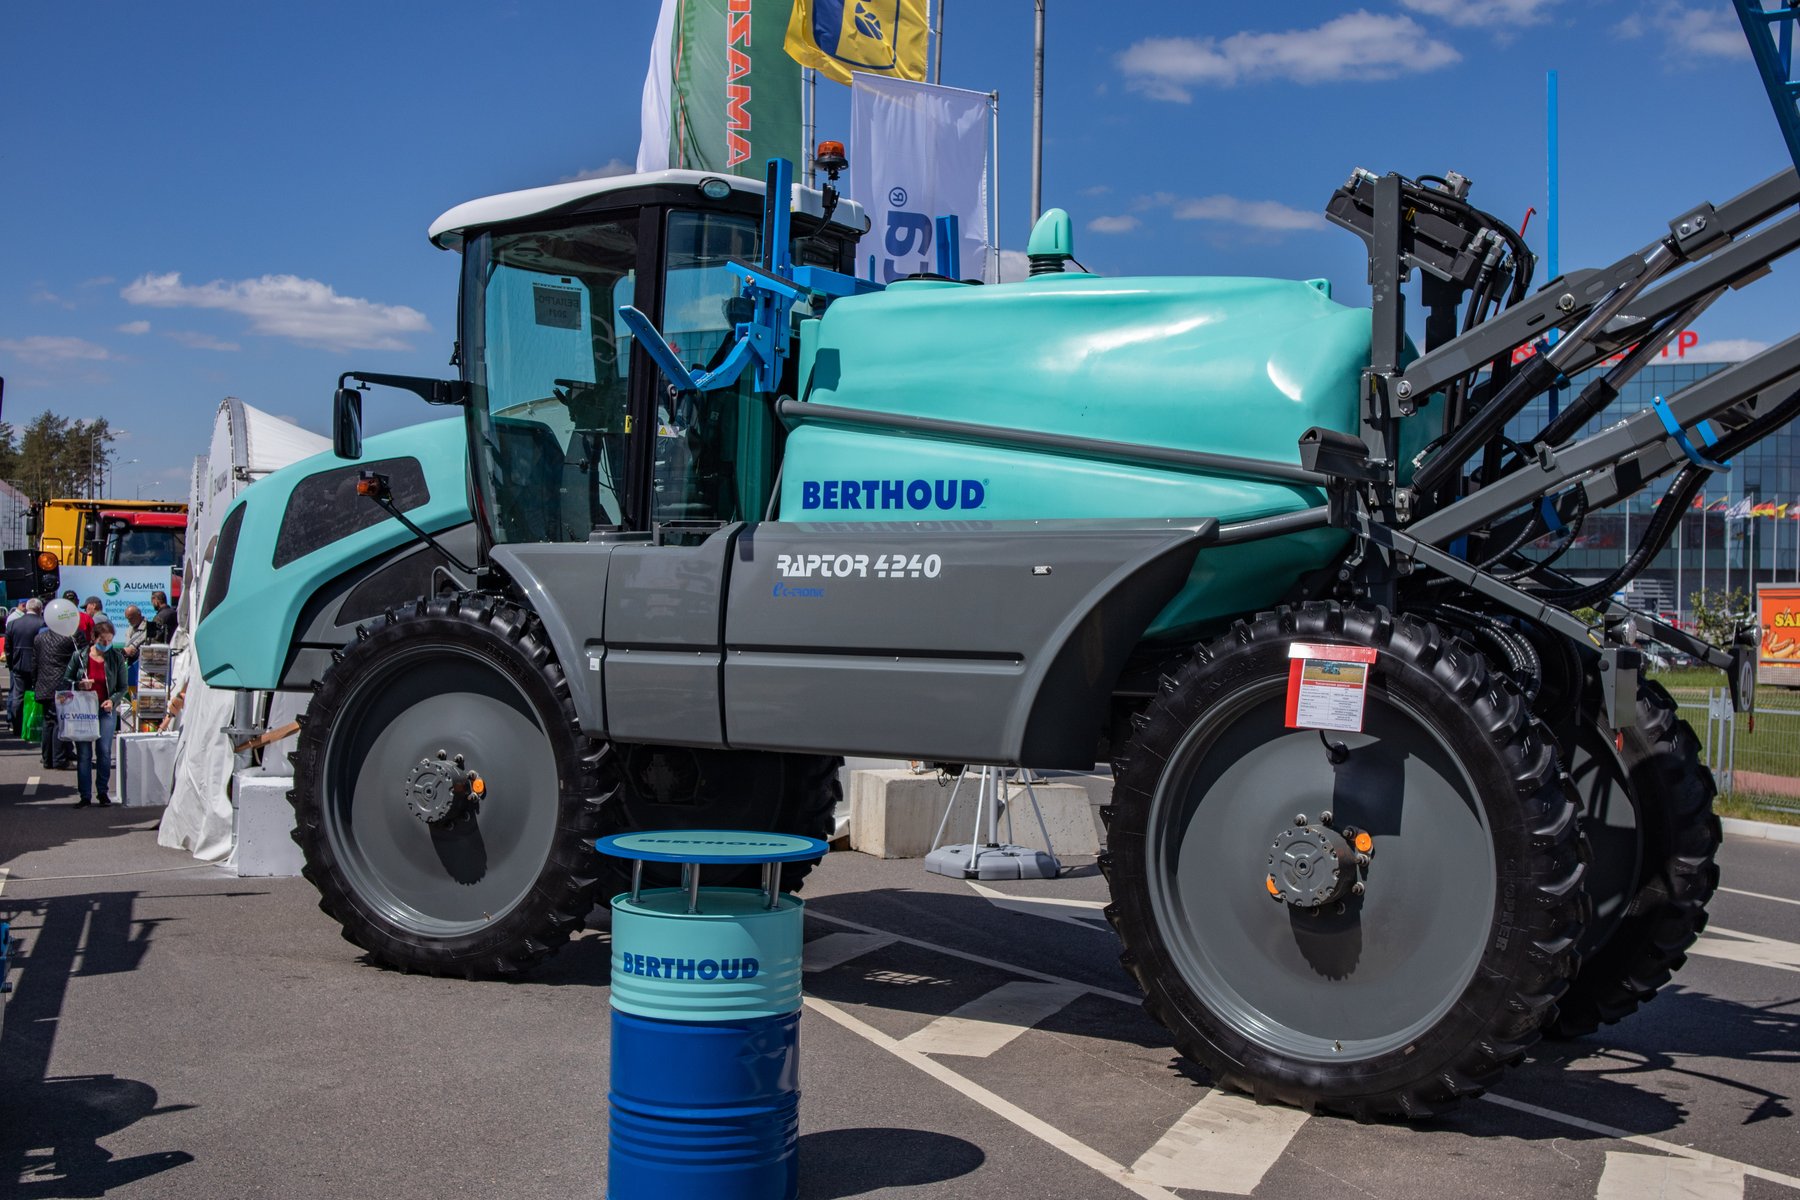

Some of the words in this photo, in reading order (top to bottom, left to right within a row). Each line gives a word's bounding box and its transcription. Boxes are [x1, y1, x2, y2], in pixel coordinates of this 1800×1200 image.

[776, 554, 868, 578] RAPTOR
[873, 553, 942, 578] 4240
[124, 582, 165, 590] AUGMENTA
[638, 838, 788, 847] BERTHOUD
[623, 951, 760, 981] BERTHOUD
